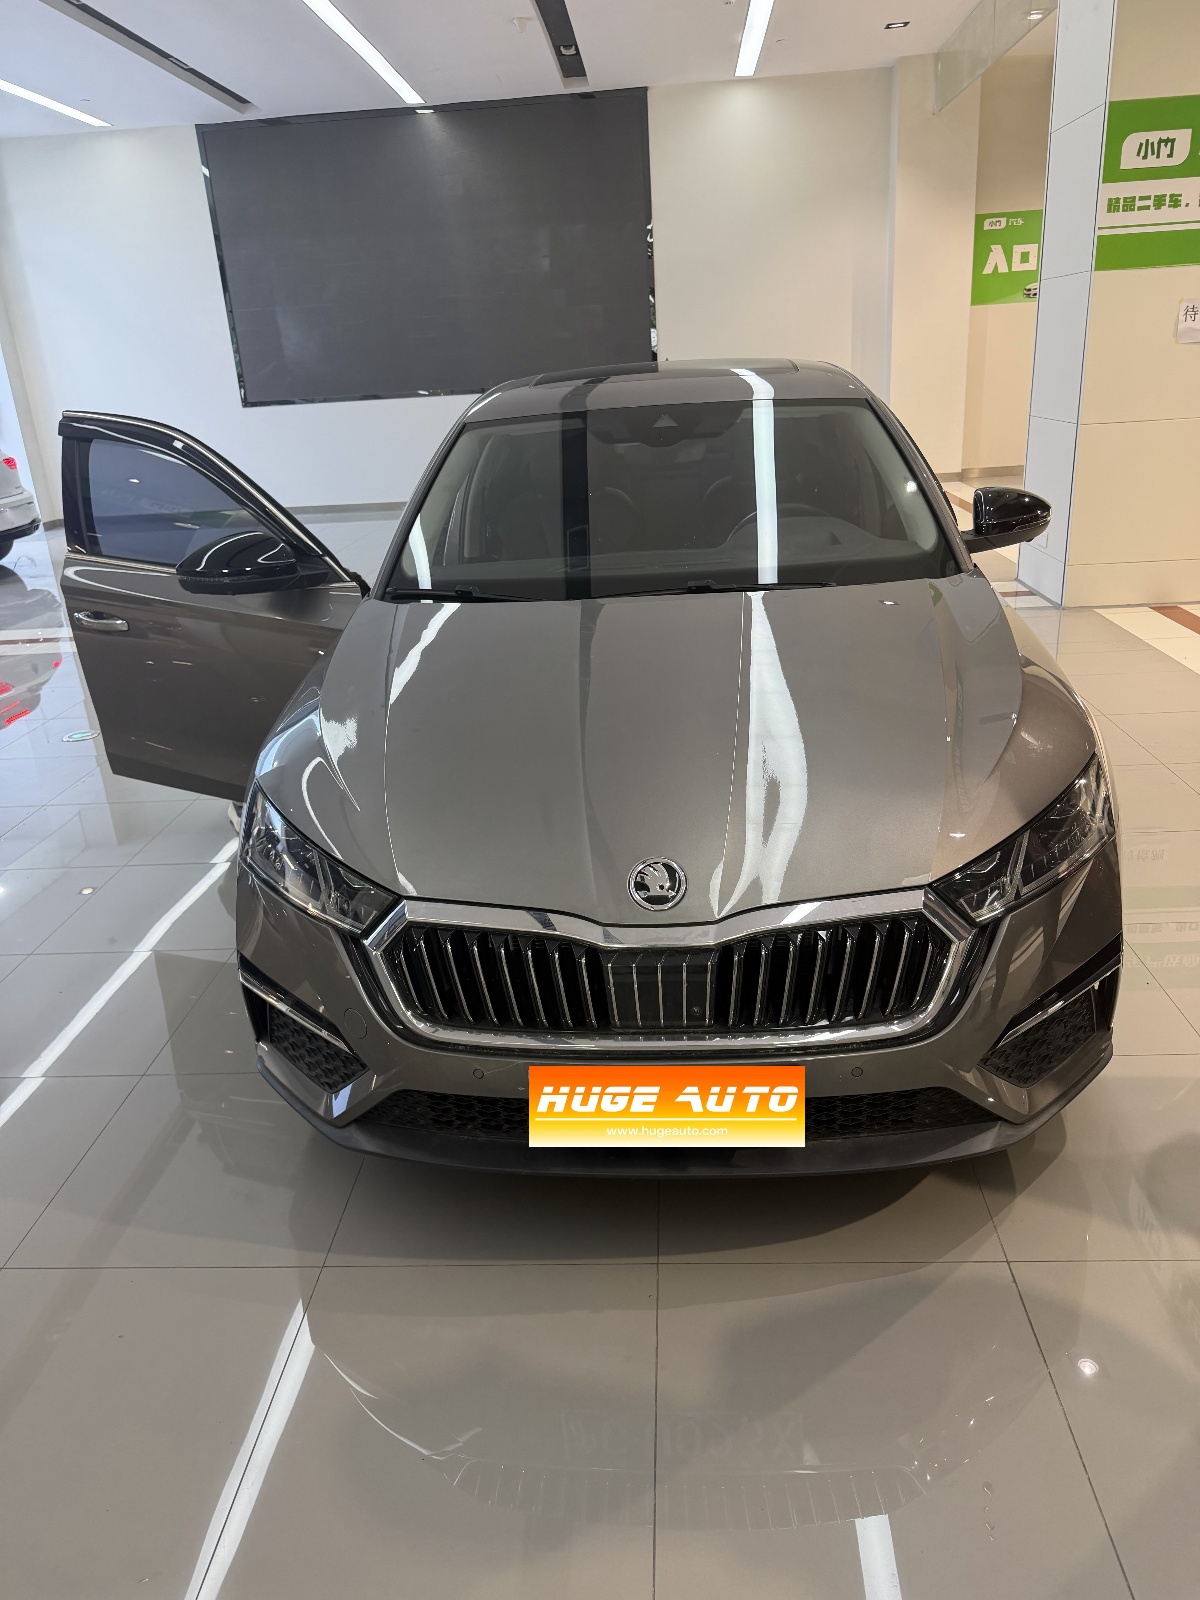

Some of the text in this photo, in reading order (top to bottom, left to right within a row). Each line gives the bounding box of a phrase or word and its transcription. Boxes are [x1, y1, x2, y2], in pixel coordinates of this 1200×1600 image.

[1136, 137, 1176, 160] 小竹
[1107, 193, 1200, 213] 精品二手车，
[982, 244, 1039, 275] 入口
[1183, 304, 1200, 323] 待
